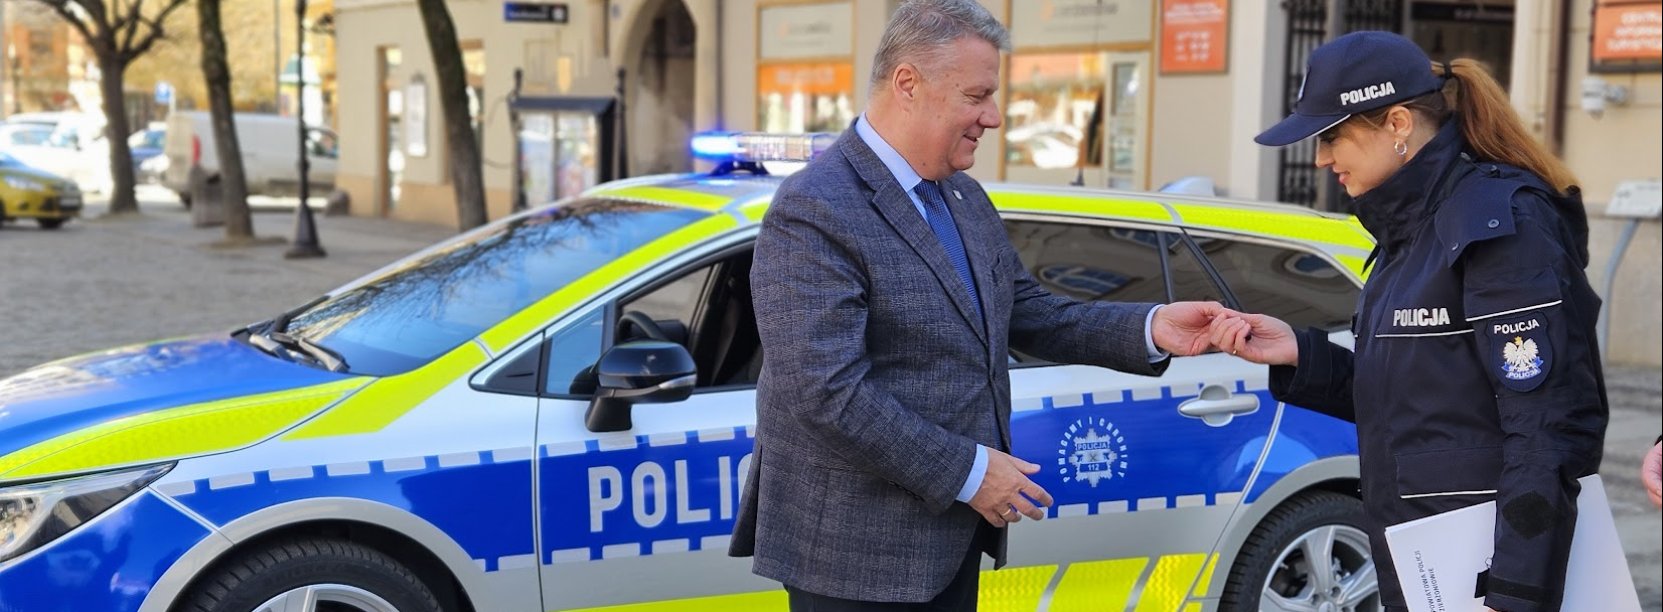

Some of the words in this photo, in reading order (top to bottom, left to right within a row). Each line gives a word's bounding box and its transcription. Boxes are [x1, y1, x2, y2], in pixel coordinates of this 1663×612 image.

[1340, 81, 1396, 106] POLICJA
[1392, 307, 1451, 327] POLICJA
[1493, 318, 1540, 335] POLICJA
[1058, 418, 1083, 483] POMAGAMY
[1099, 417, 1129, 478] CHRONIMY
[1077, 442, 1108, 451] POLICJA
[1087, 463, 1100, 472] 112
